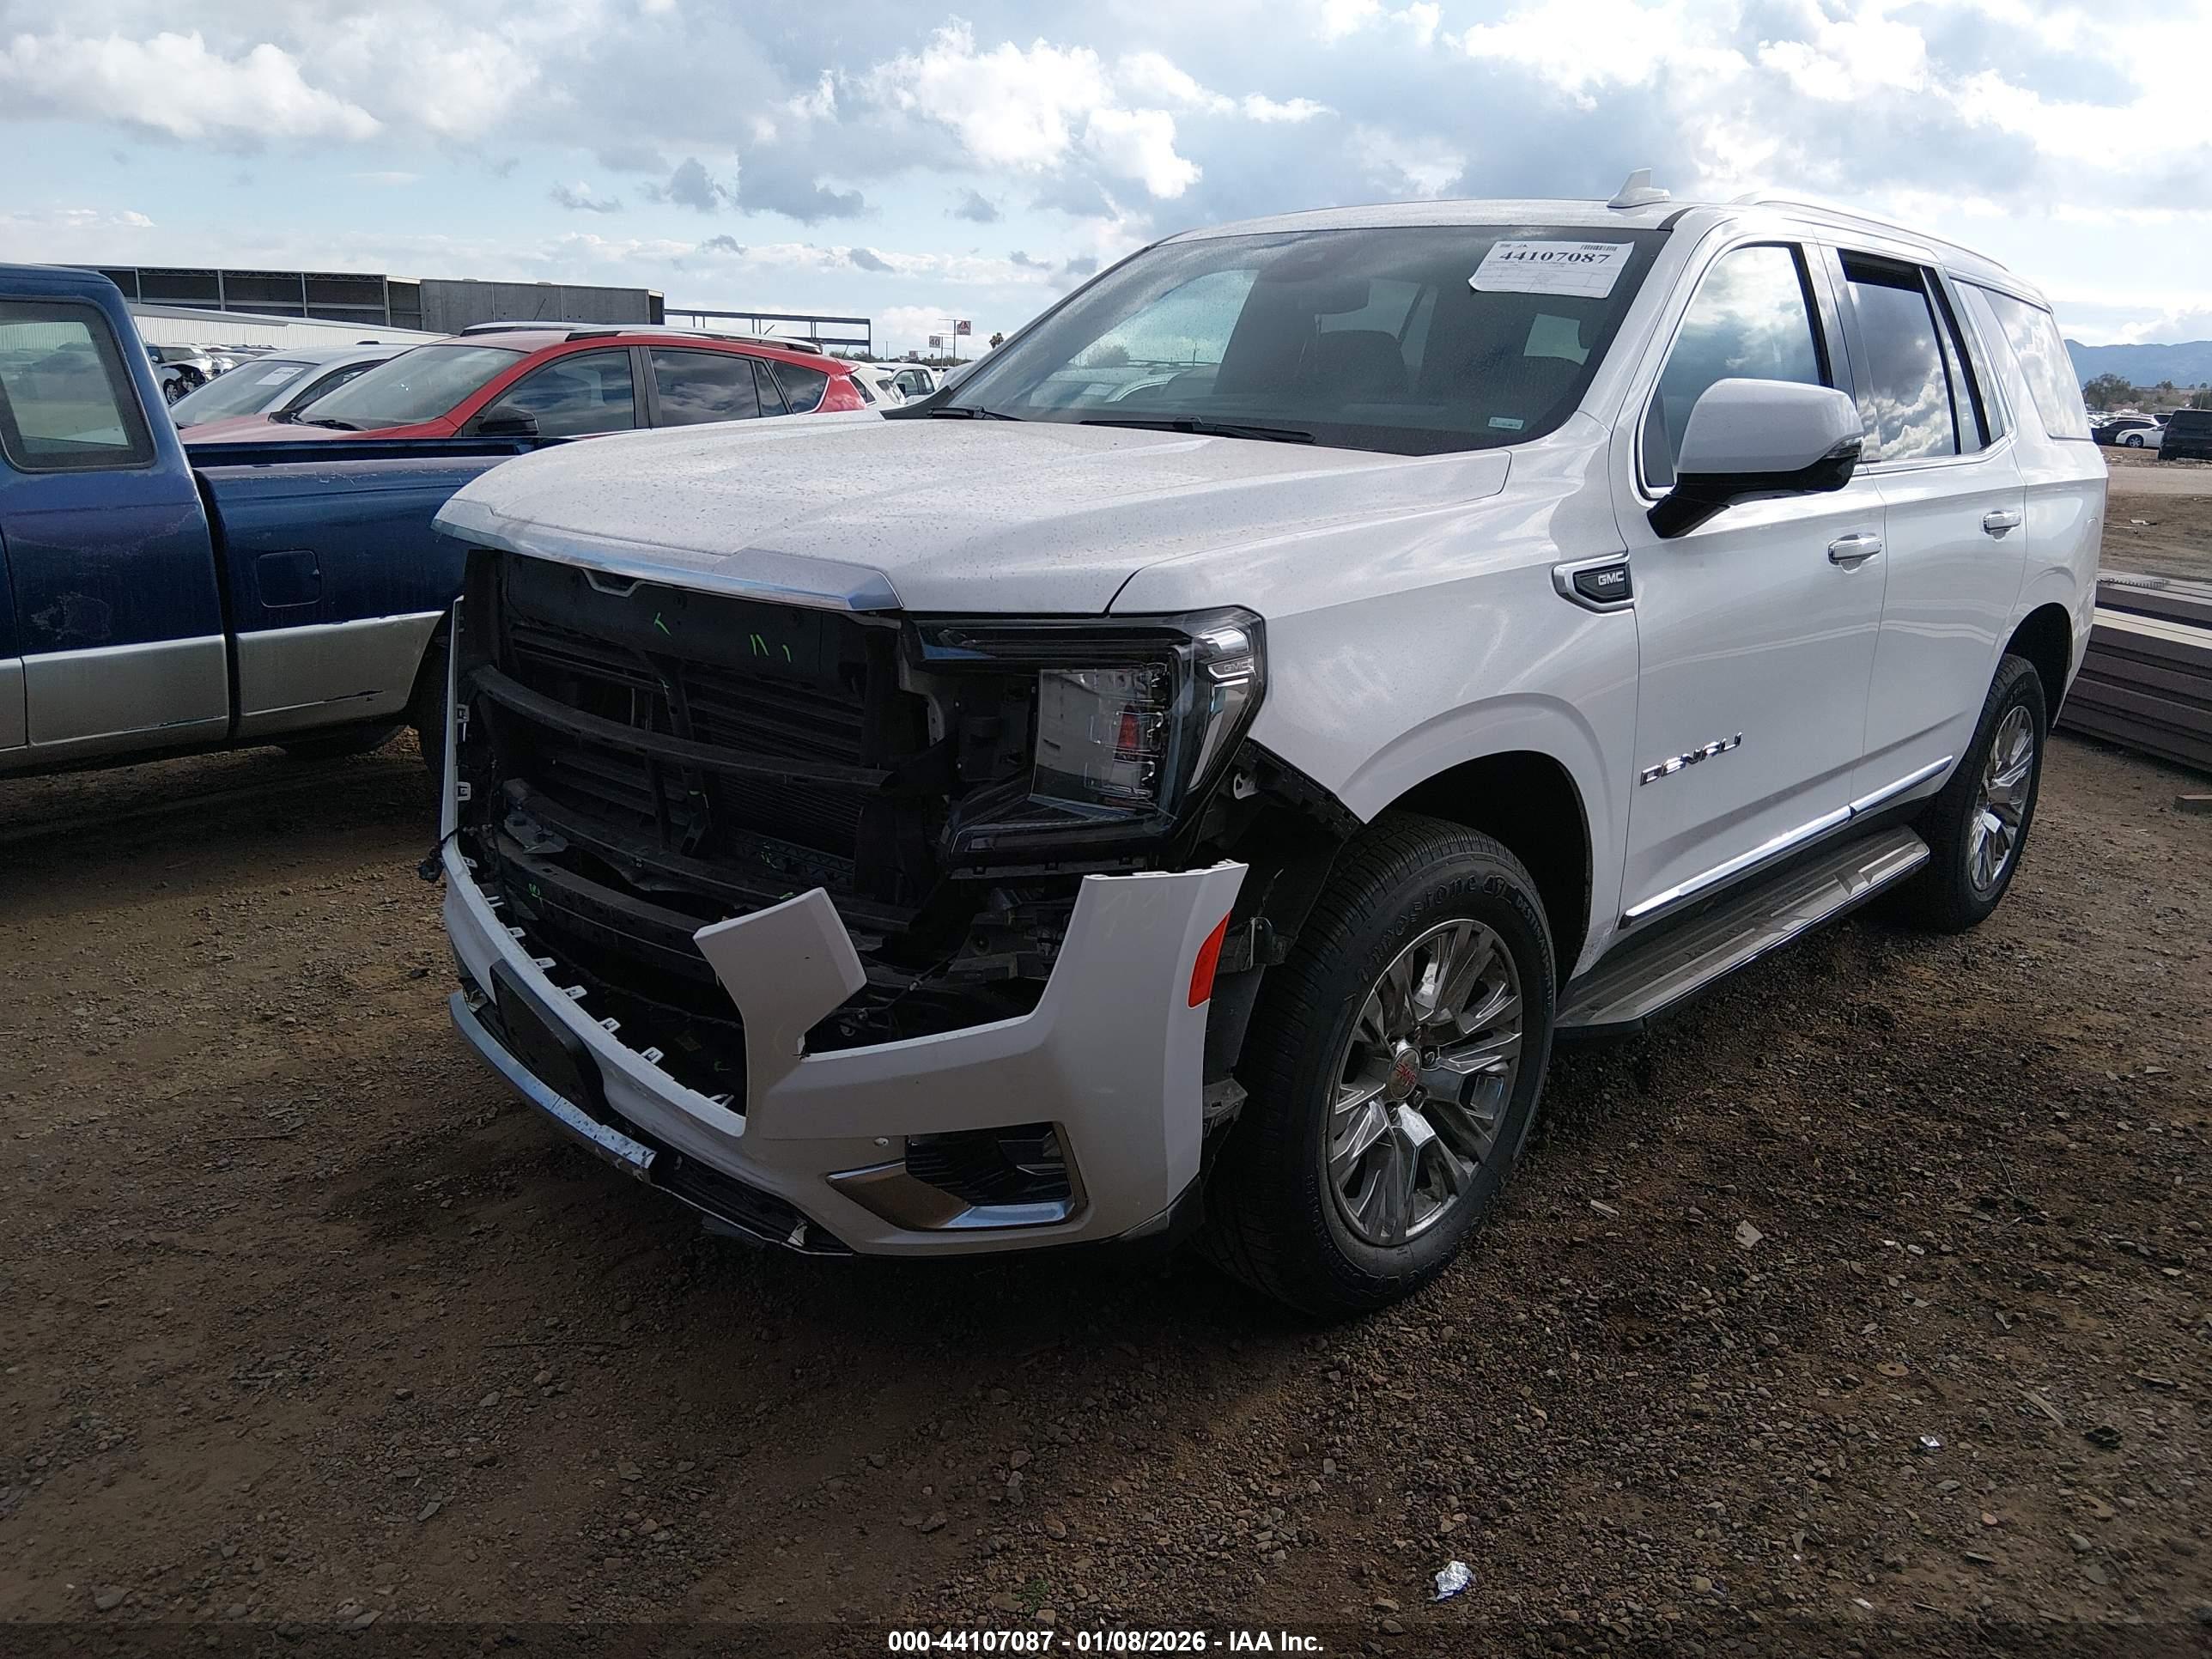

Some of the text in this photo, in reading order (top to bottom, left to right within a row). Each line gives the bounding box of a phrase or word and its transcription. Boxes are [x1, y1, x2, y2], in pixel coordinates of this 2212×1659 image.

[1498, 250, 1612, 264] 44107087
[1597, 569, 1626, 586] GMC
[1223, 660, 1250, 672] GMC
[1639, 731, 1743, 787] DENALI
